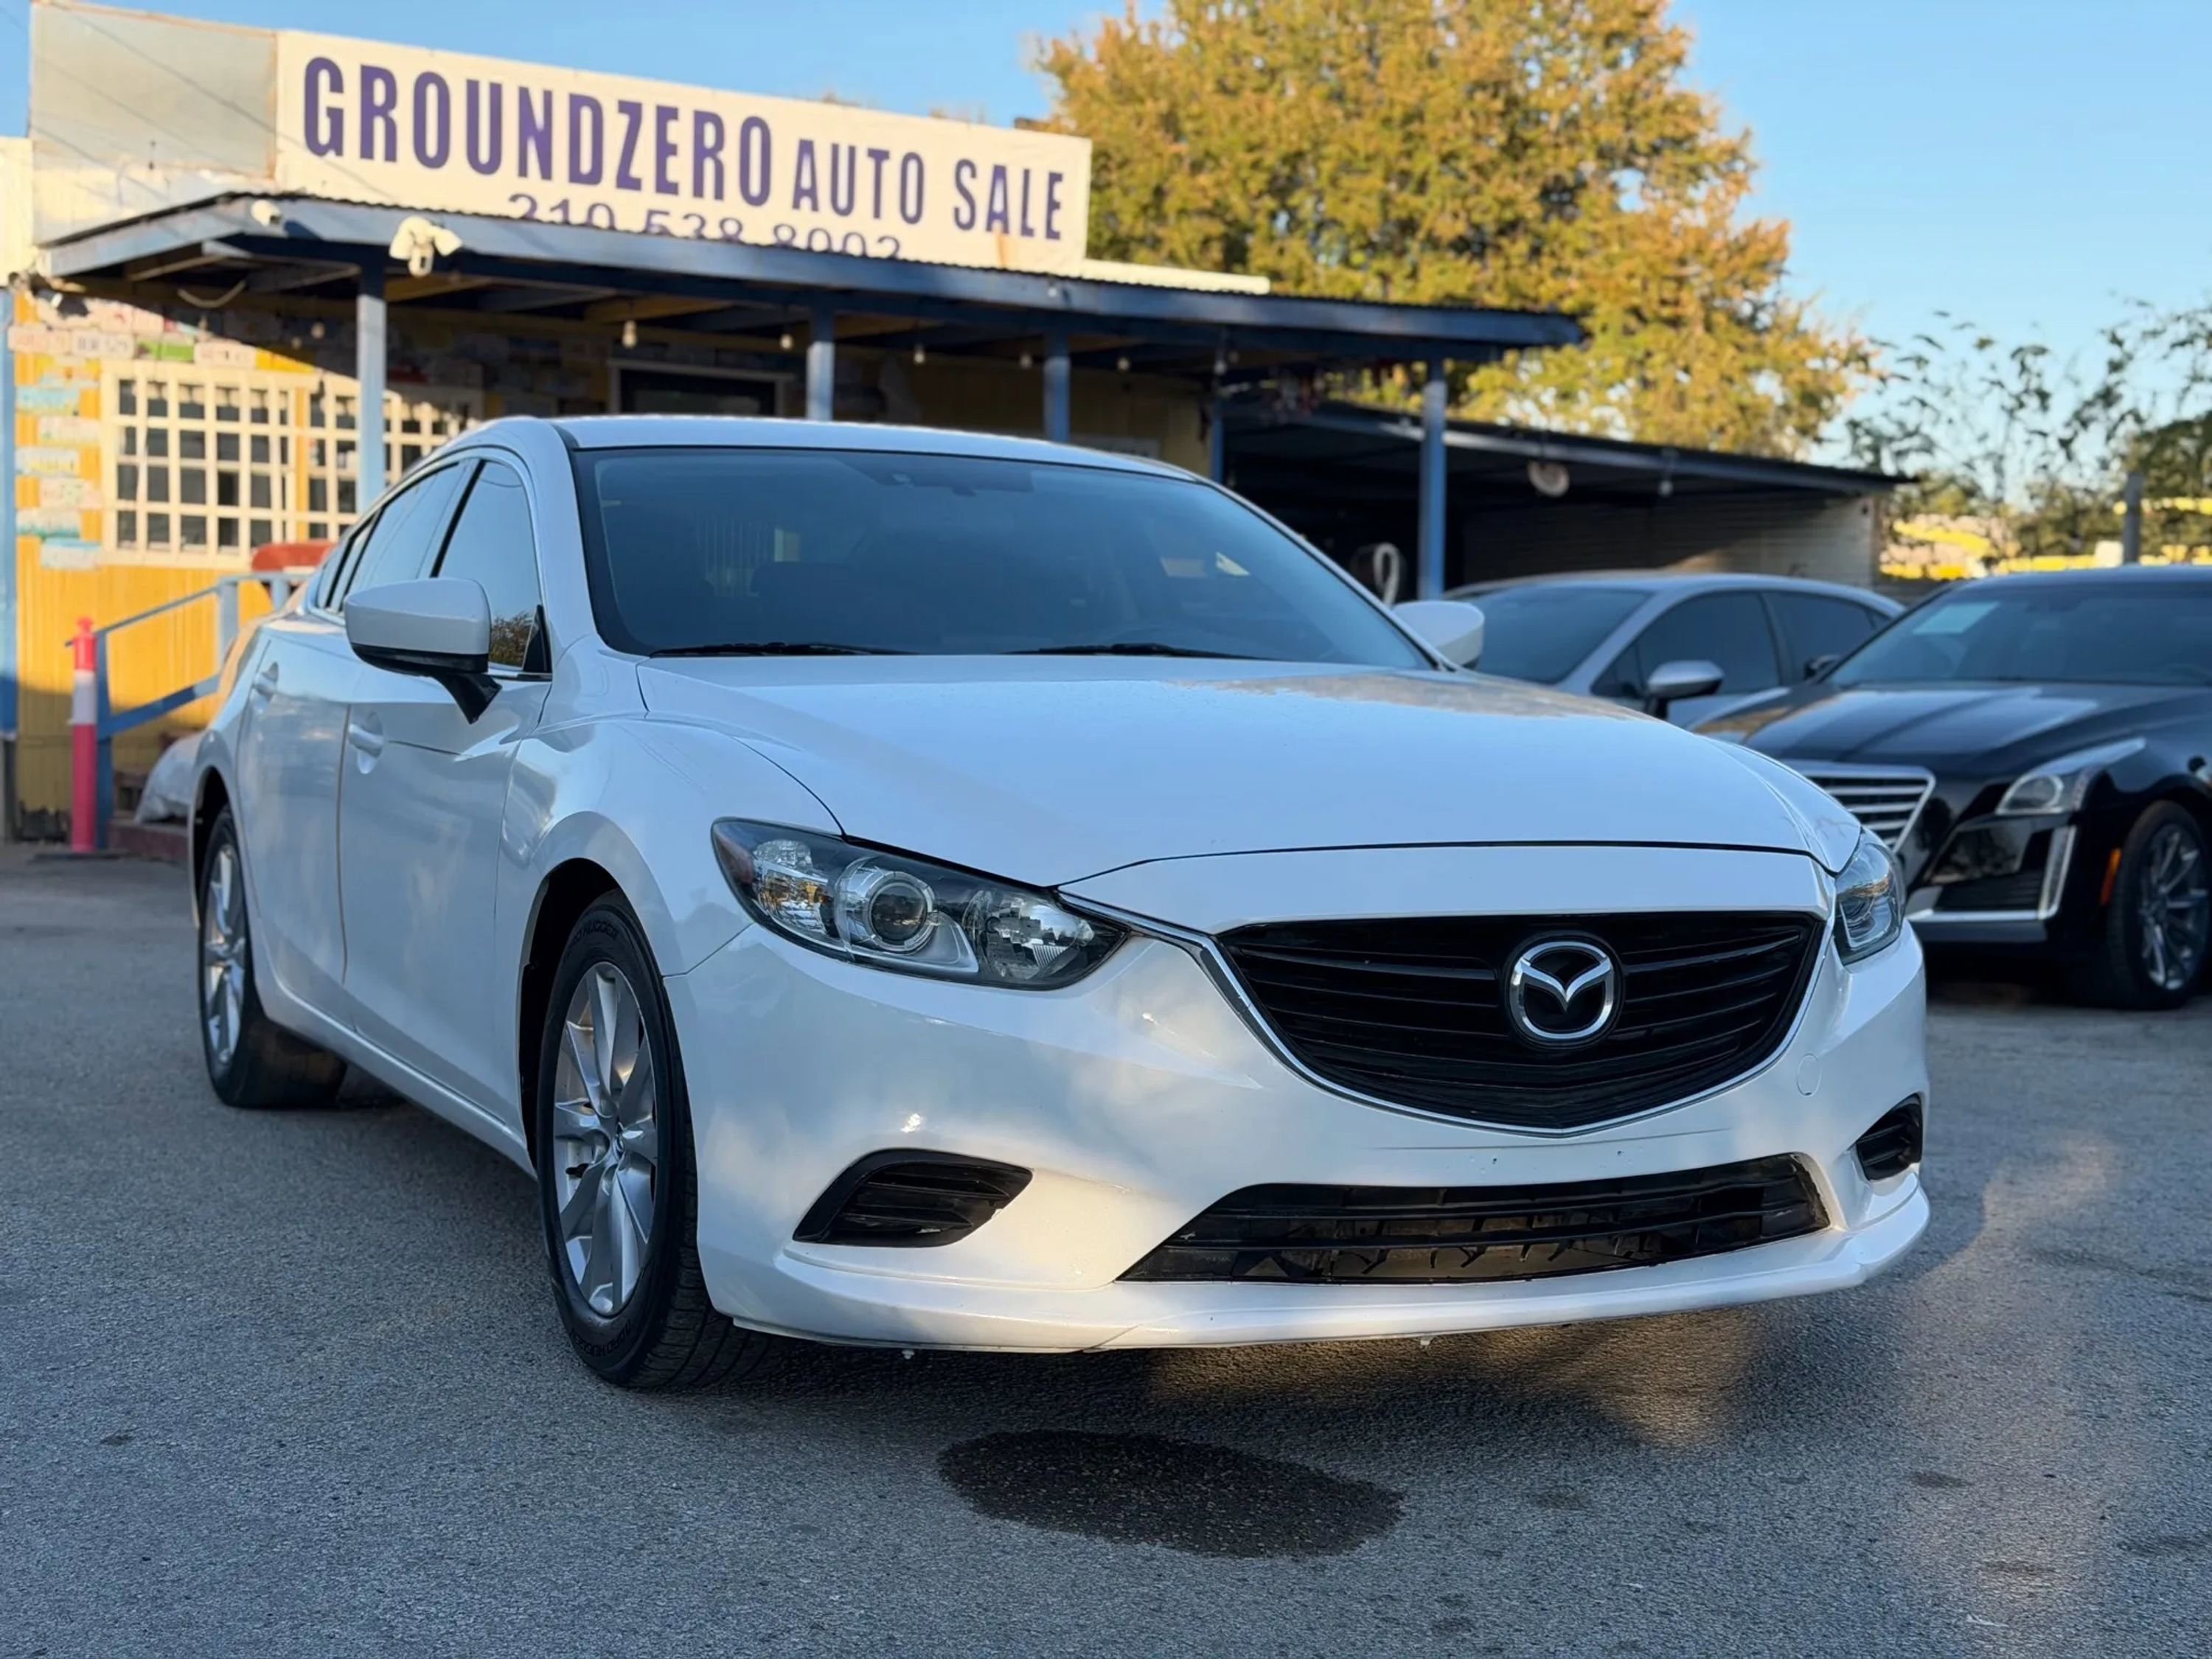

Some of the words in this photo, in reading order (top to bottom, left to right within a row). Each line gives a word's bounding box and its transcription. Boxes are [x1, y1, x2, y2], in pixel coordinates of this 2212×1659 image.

[303, 56, 772, 206] GROUNDZERO
[792, 139, 925, 224] AUTO
[953, 159, 1064, 240] SALE
